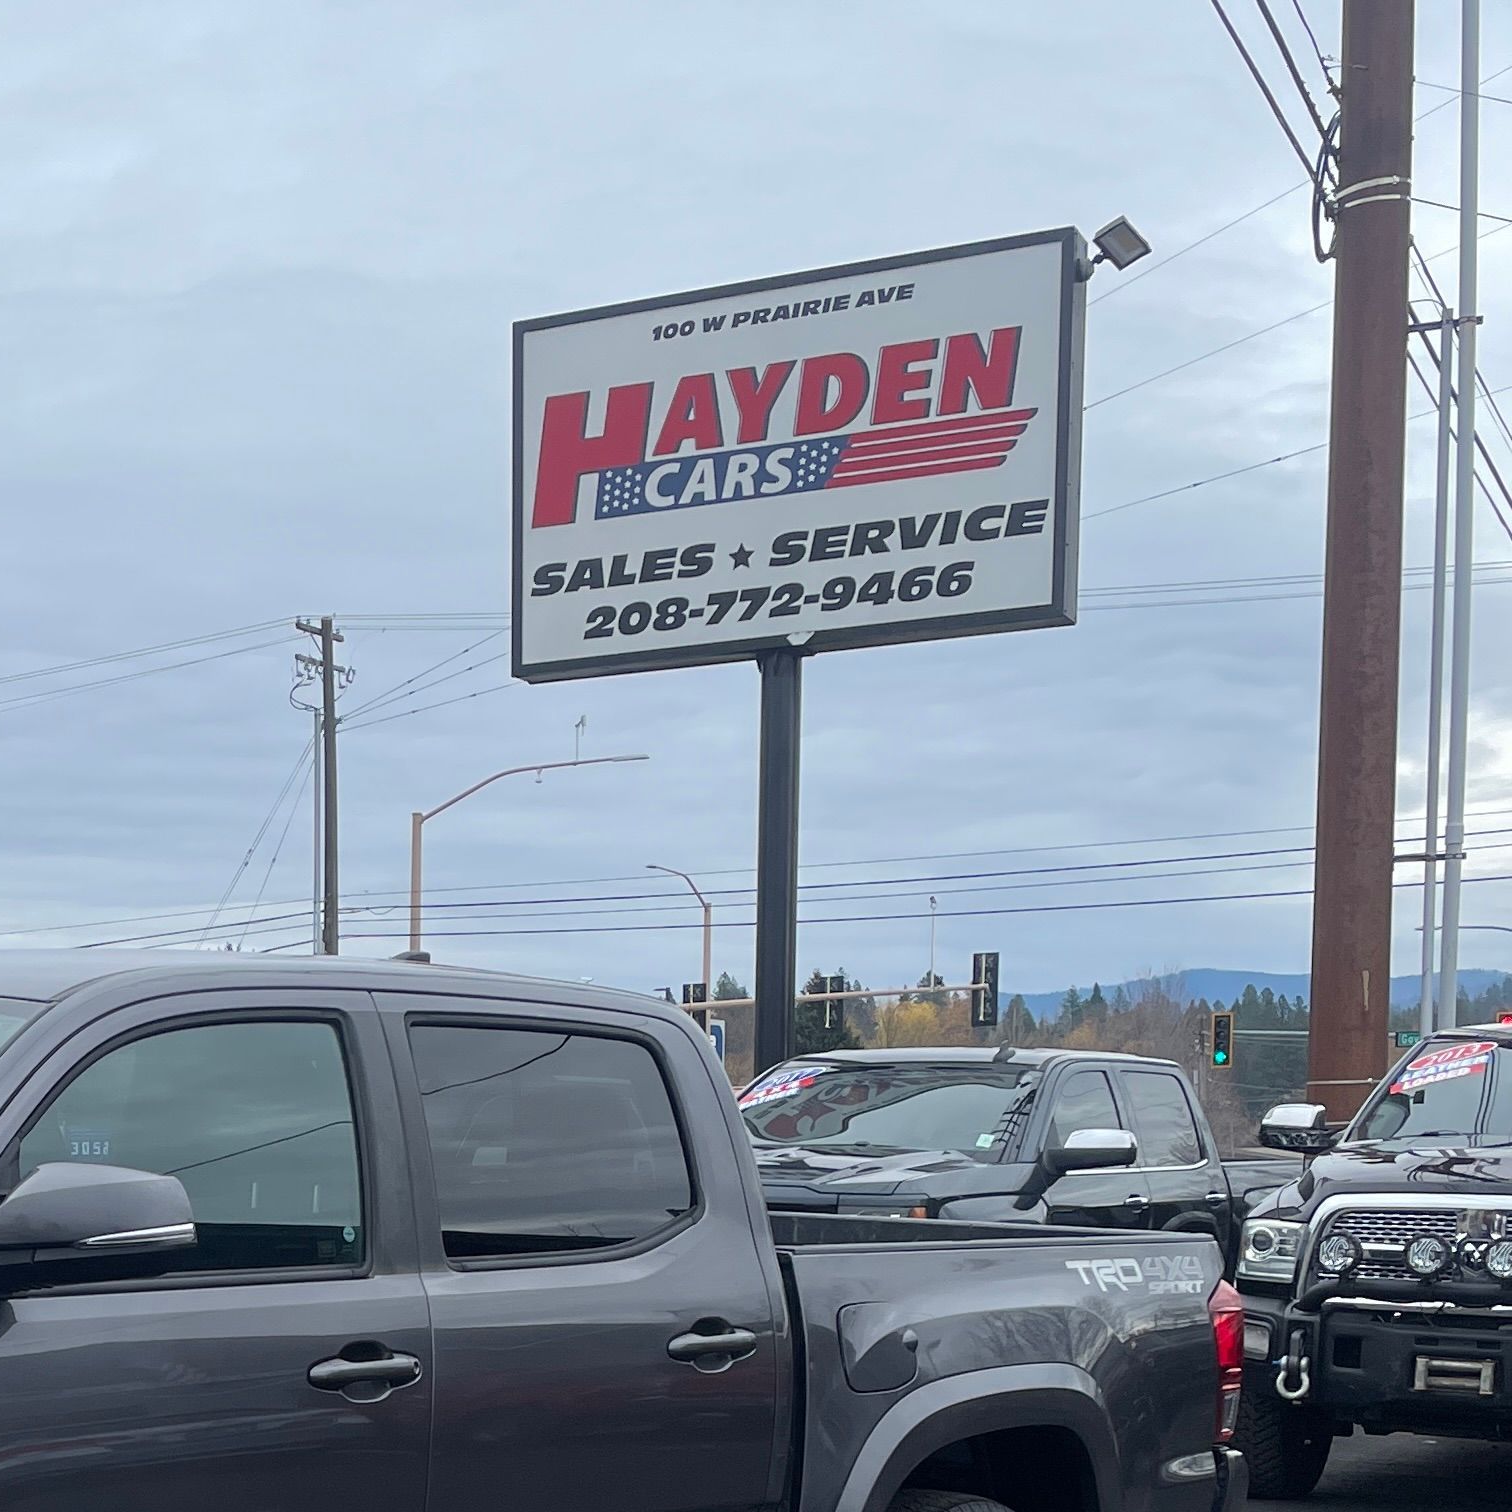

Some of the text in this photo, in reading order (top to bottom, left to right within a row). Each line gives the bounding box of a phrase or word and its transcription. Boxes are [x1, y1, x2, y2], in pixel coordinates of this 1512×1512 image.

[652, 283, 916, 341] 100 W PRAIRIE AVE
[531, 325, 1023, 529] HAYDEN
[643, 447, 796, 508] CARS
[530, 498, 1050, 597] SALES SERVICE
[583, 561, 976, 641] 208-772-9466
[1401, 1066, 1472, 1091] LOADED
[1064, 1258, 1144, 1292] TRD
[1147, 1279, 1206, 1295] SPORT
